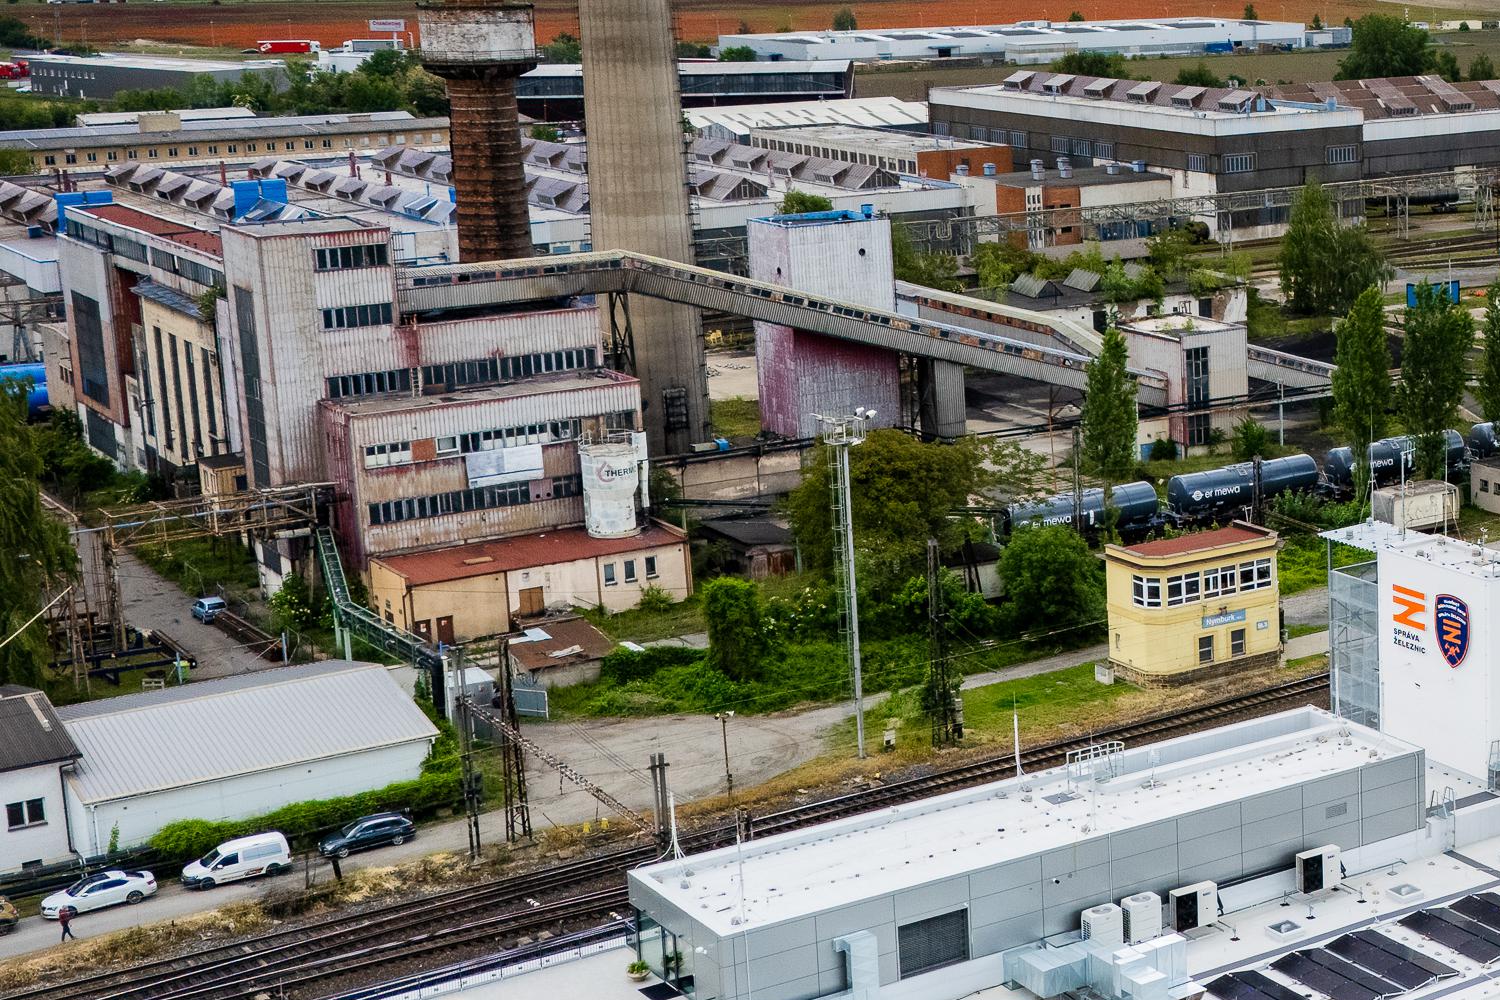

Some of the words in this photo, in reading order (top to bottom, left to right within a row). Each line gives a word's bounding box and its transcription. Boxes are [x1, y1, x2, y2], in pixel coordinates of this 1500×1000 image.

[1206, 613, 1235, 626] Nymburk
[1393, 627, 1420, 643] SPRÁVA
[1393, 635, 1426, 654] ŽELEZNIC
